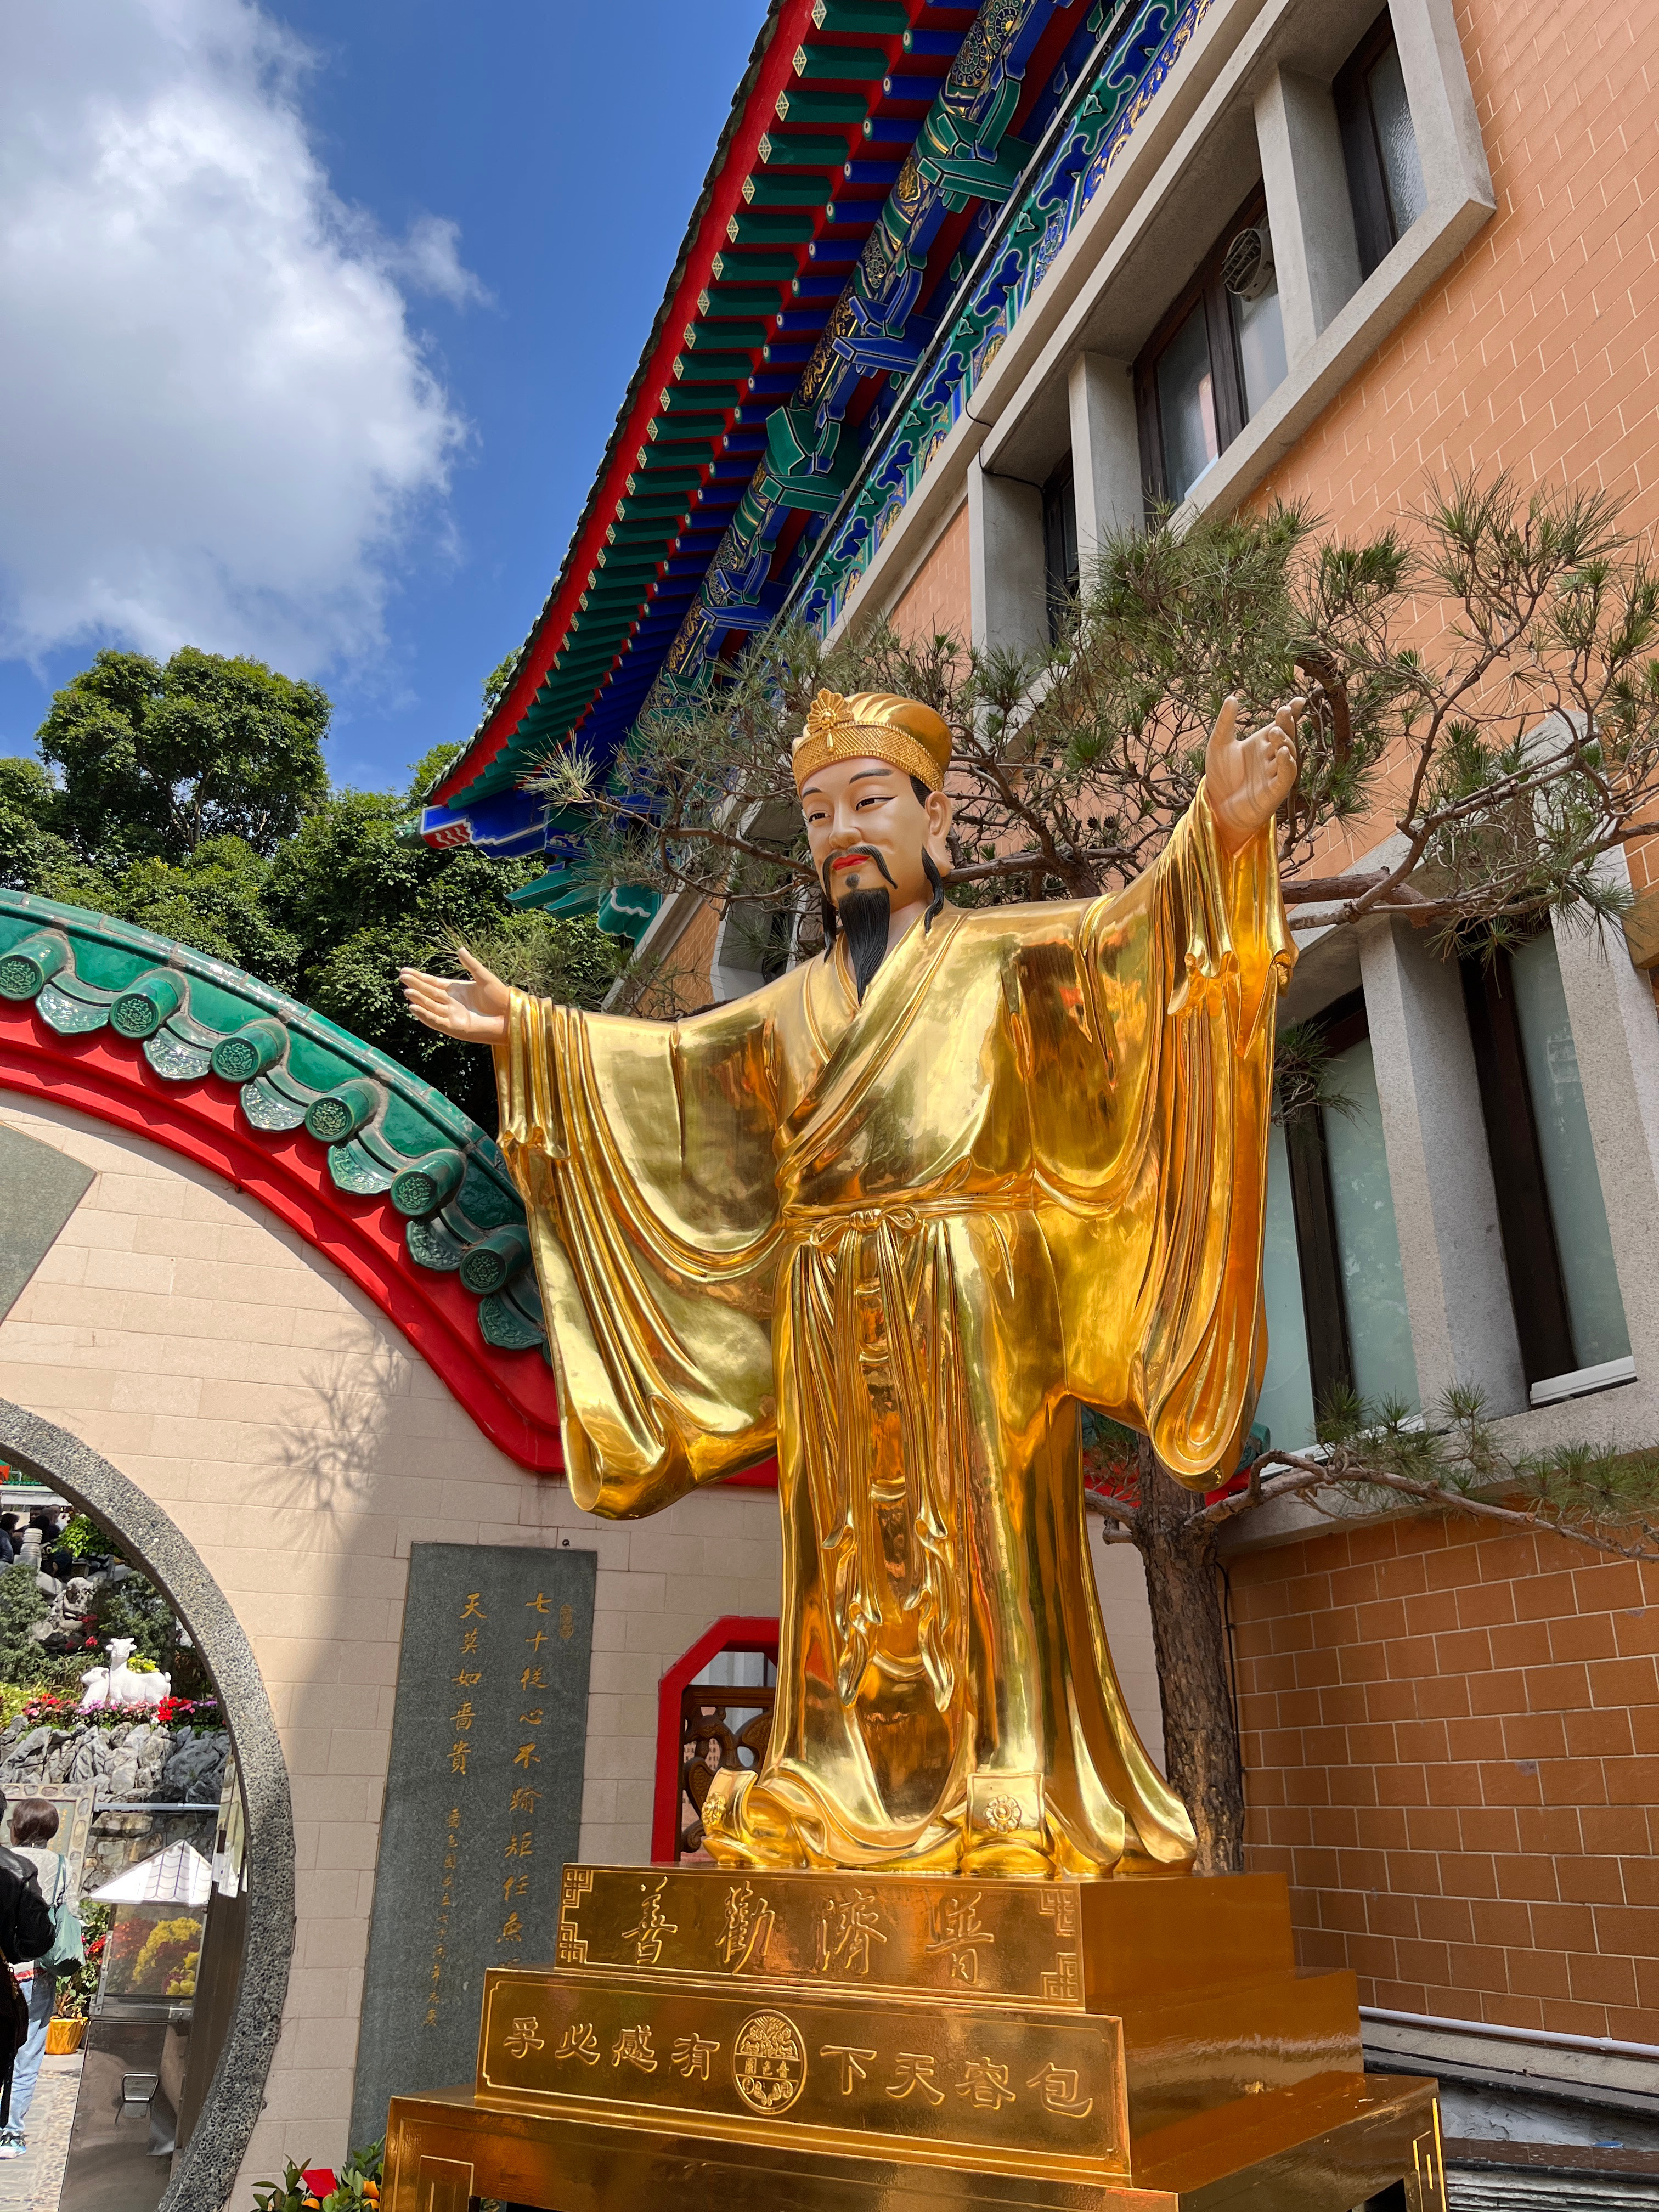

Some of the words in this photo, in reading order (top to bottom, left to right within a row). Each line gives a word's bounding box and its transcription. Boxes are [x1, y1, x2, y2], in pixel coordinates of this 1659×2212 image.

[495, 1592, 553, 1966] 七十從心不踰矩任魚
[503, 2016, 720, 2081] 有感必孚
[819, 2044, 1094, 2119] 包容天下
